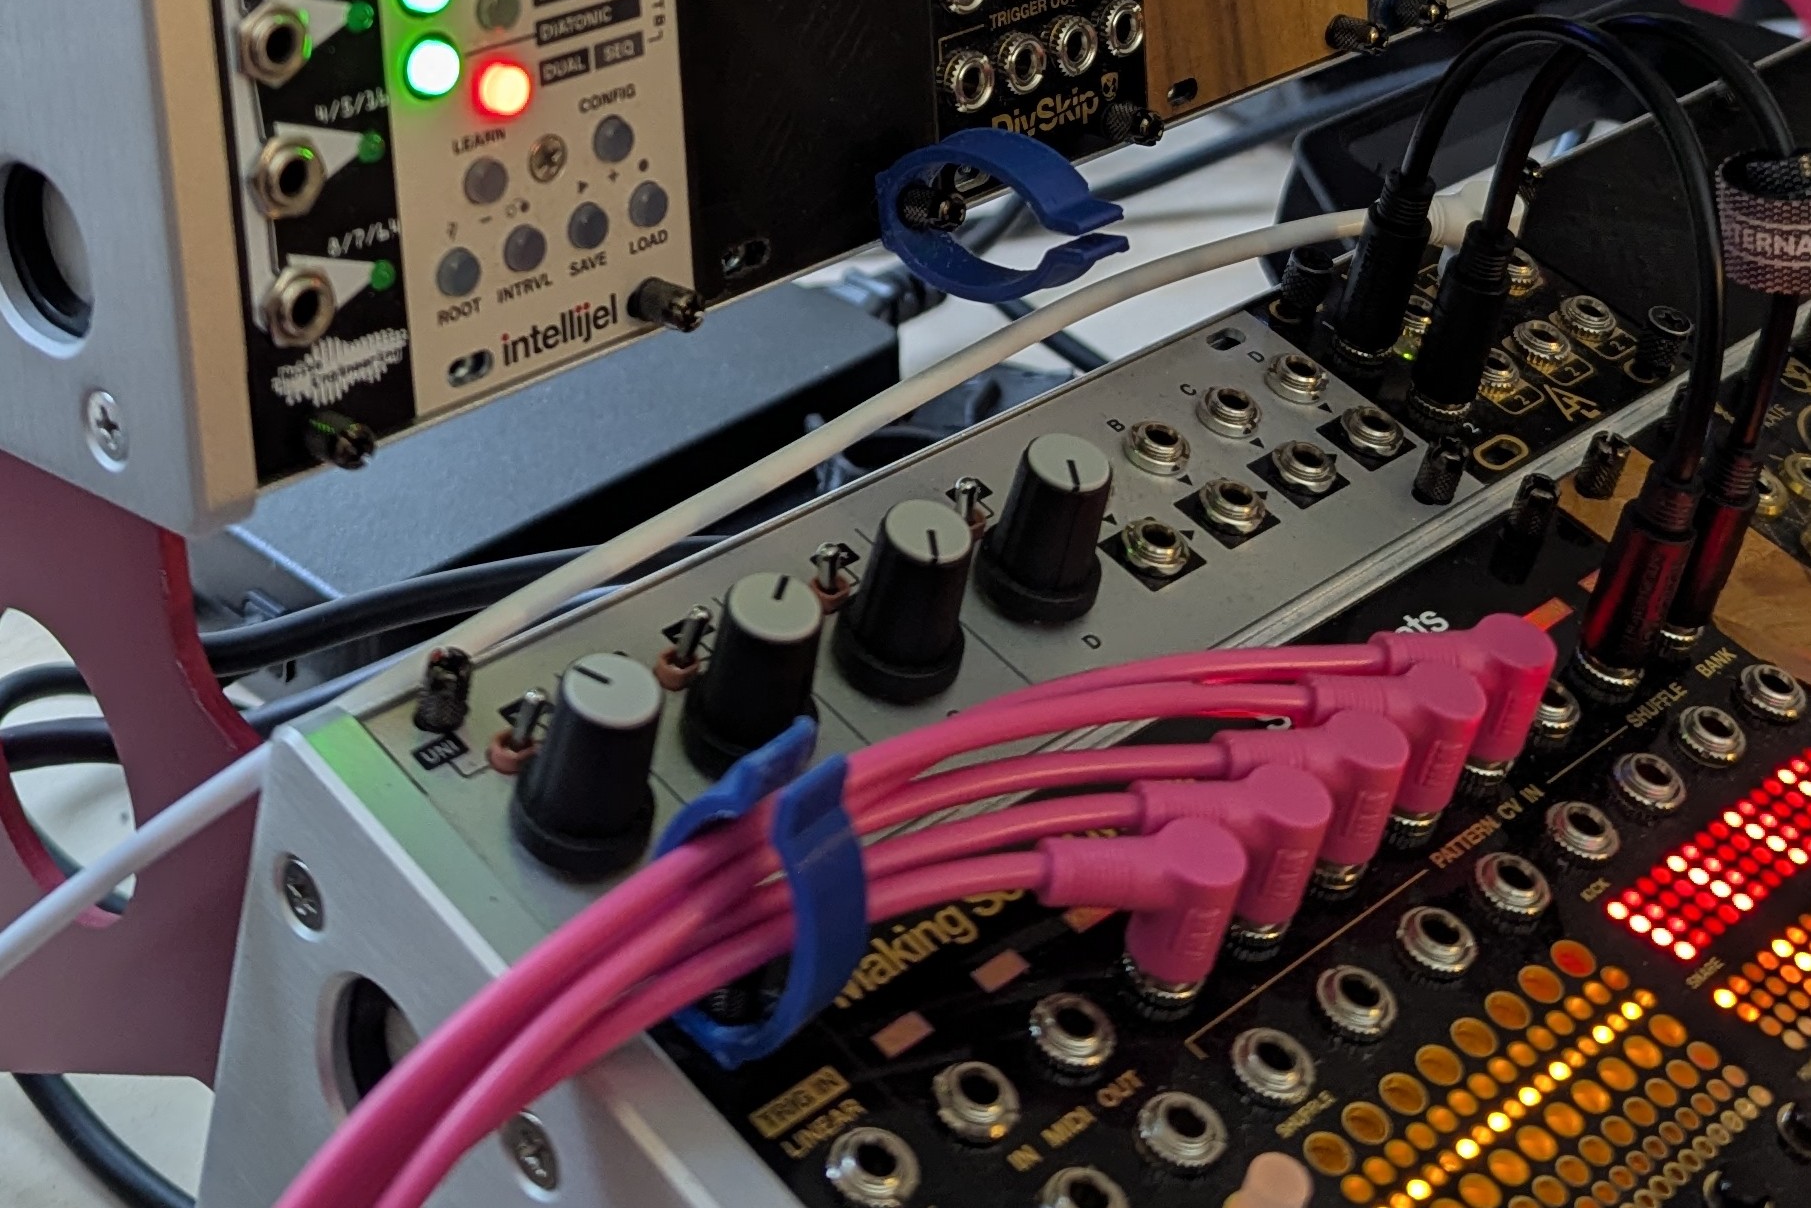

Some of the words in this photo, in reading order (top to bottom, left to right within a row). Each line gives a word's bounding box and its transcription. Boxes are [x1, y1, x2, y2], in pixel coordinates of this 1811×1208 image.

[539, 5, 613, 43] DIATONIC
[653, 13, 667, 27] B
[542, 55, 587, 82] DUAL
[603, 39, 635, 63] SEQ
[578, 82, 637, 114] CONFIG
[451, 127, 507, 155] LEARN
[628, 228, 669, 256] LOAD
[1733, 225, 1811, 257] TERNA
[569, 250, 609, 277] SAVE
[496, 272, 553, 304] INTRVL
[436, 296, 483, 327] ROOT
[501, 292, 619, 368] intellijel
[1247, 350, 1265, 364] D
[1179, 383, 1198, 397] C
[1106, 418, 1126, 433] B
[1081, 633, 1101, 650] D
[1694, 647, 1738, 680] BANK
[1624, 680, 1689, 729] SHUFFLE
[419, 738, 461, 765] UNI
[1428, 814, 1500, 870] PATTERN
[1496, 797, 1525, 821] CV
[1519, 783, 1545, 805] IN
[779, 1097, 869, 1160] LINEAR
[1006, 1143, 1044, 1173] IN
[1040, 1105, 1098, 1149] MIDI
[1097, 1068, 1146, 1109] OUT
